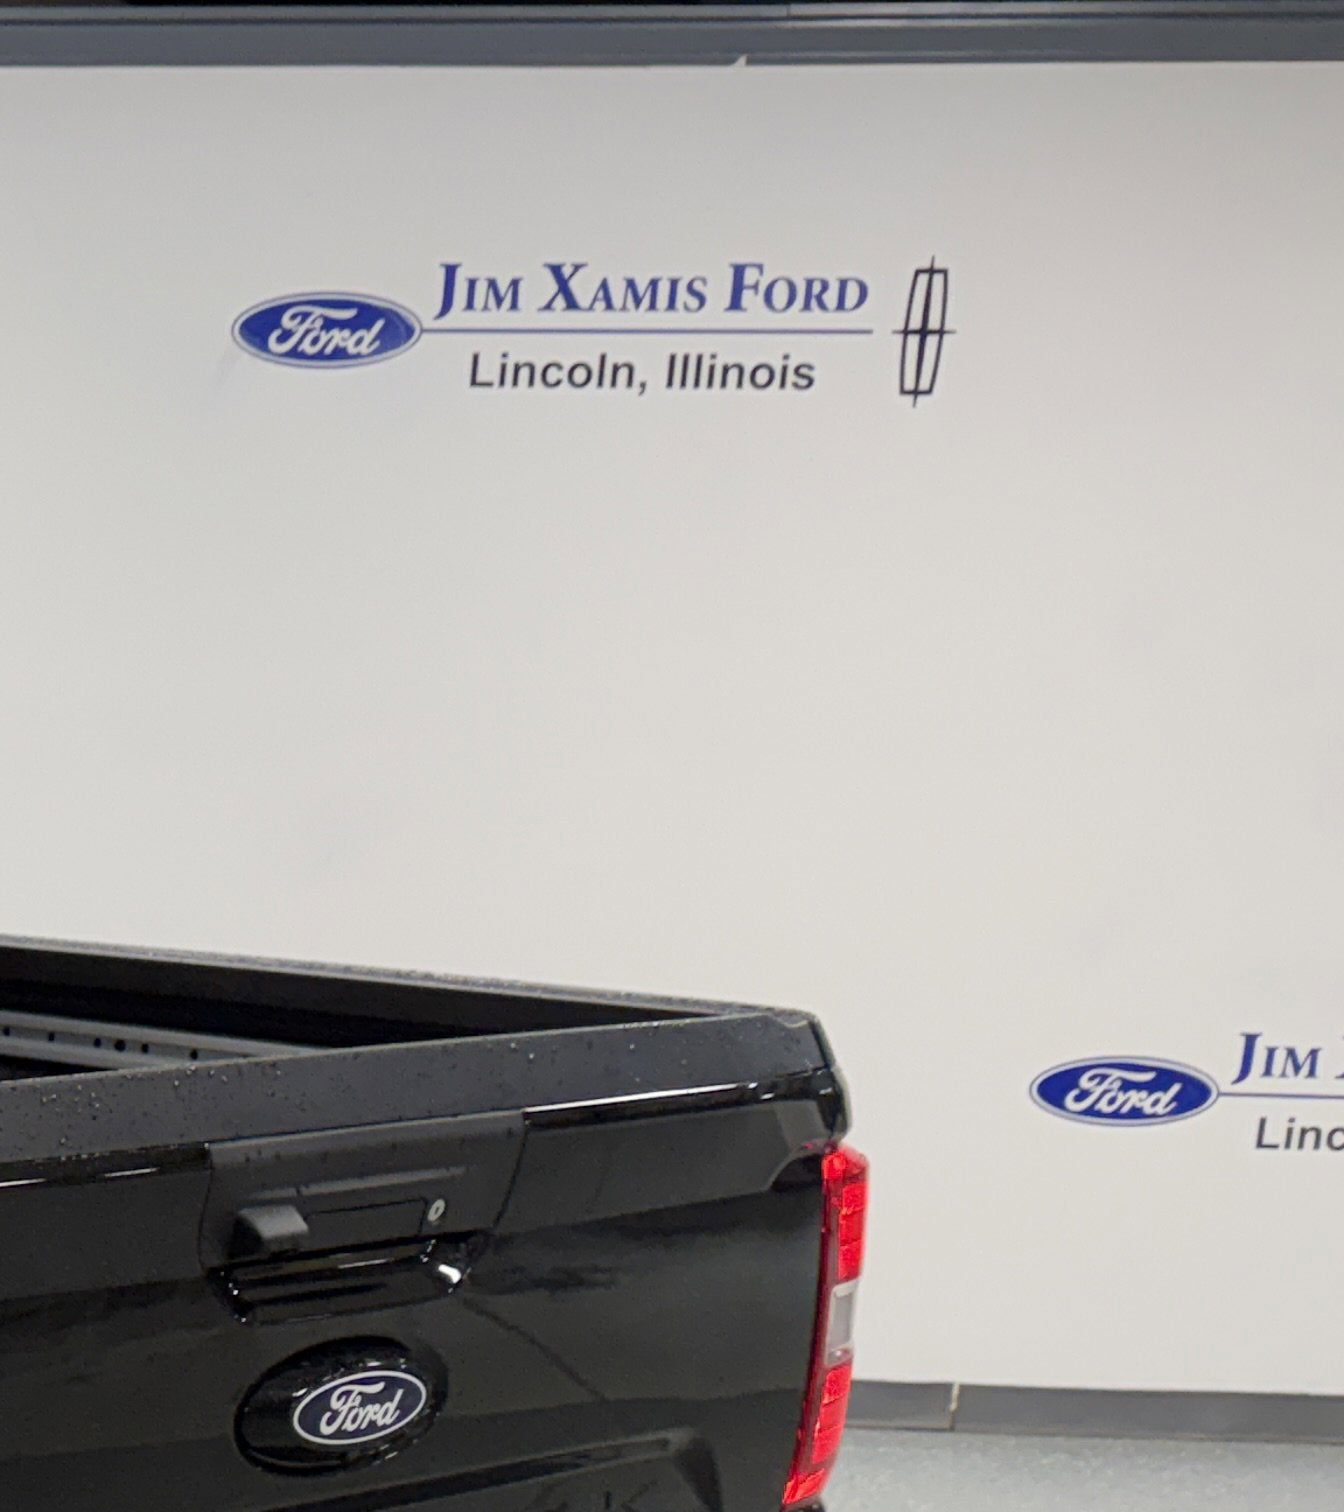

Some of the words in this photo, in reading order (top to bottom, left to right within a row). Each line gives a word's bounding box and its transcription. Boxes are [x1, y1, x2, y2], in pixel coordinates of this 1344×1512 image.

[433, 263, 524, 321] JIM
[538, 263, 709, 314] XAMIS
[727, 263, 870, 314] FORD
[268, 306, 380, 356] Ford
[469, 351, 648, 396] Lincoln,
[664, 353, 816, 391] Illinois
[1230, 1032, 1323, 1085] JIM
[1064, 1067, 1183, 1116] Ford
[319, 1381, 405, 1436] Ford
